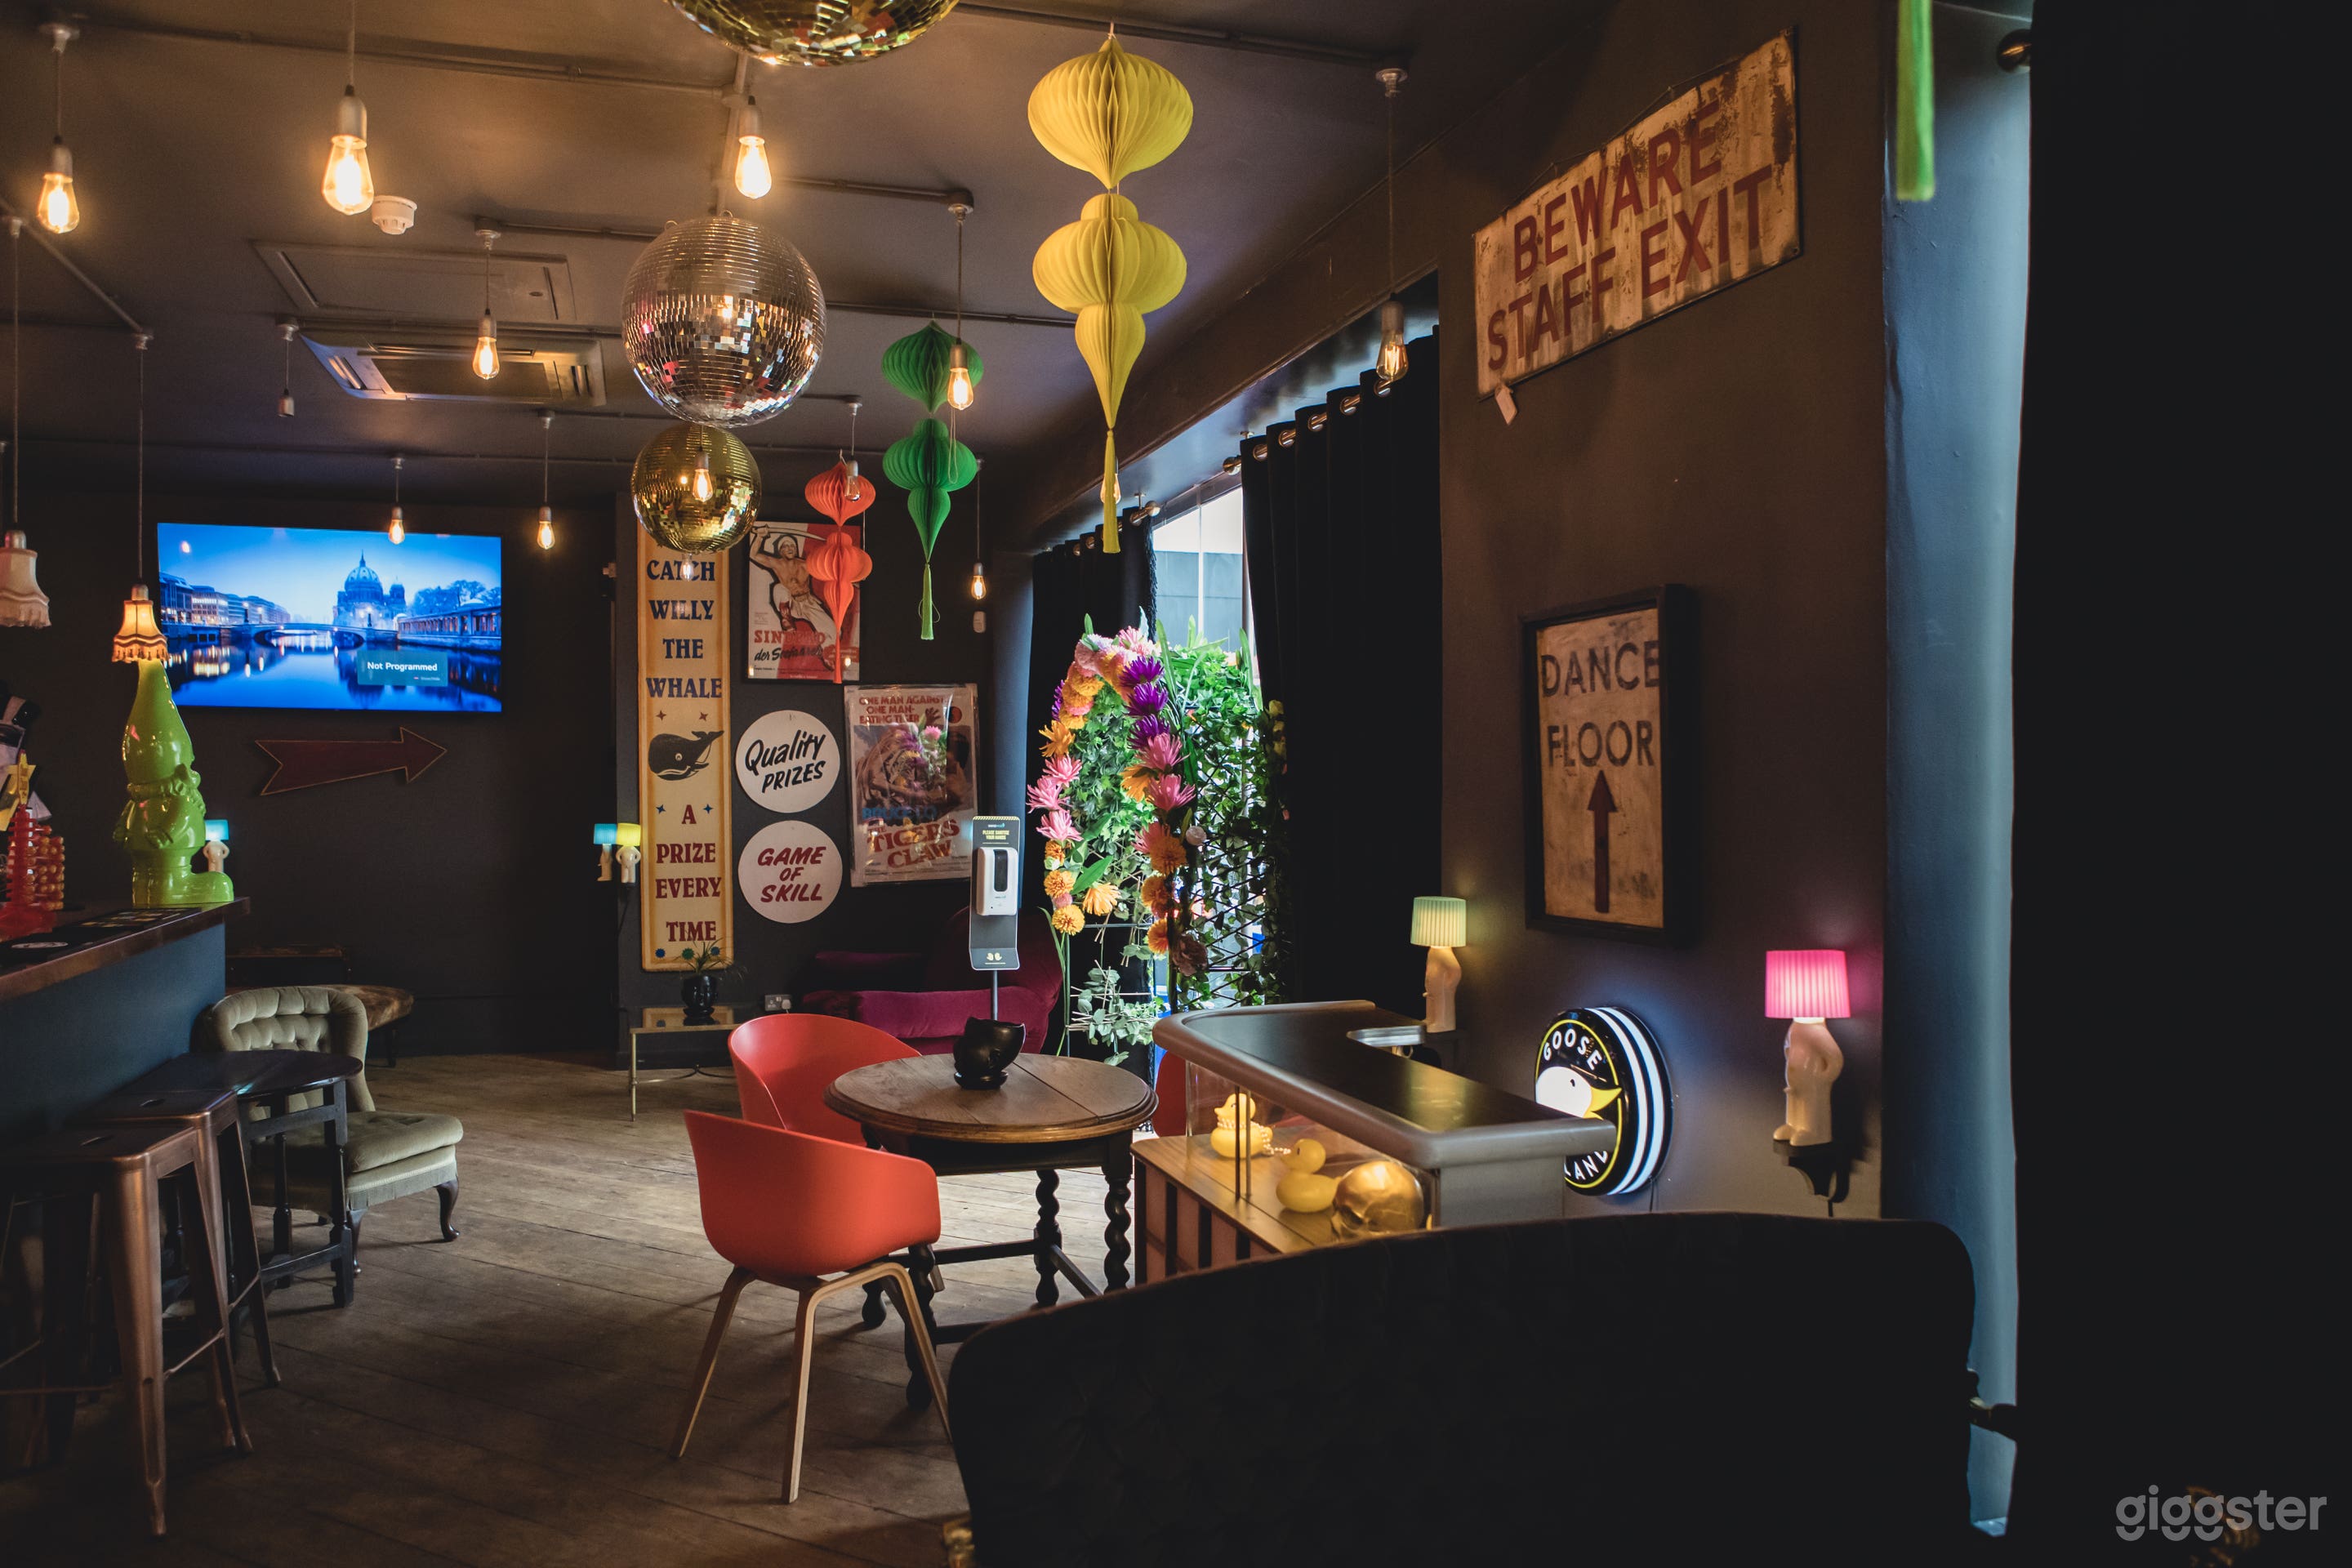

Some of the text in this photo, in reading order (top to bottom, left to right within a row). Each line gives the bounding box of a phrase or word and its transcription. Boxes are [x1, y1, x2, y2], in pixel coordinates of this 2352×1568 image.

[1514, 99, 1722, 284] BEWARE
[1487, 164, 1772, 370] STAFF EXIT
[648, 599, 715, 621] WILLY
[662, 638, 703, 659] THE
[754, 648, 770, 661] der
[367, 662, 438, 672] Not Programmed
[1541, 639, 1660, 697] DANCE
[645, 677, 722, 699] WHALE
[859, 696, 879, 706] ONE
[880, 696, 904, 706] MAN
[866, 705, 915, 715] ONE MAN-
[859, 714, 893, 724] EATING
[745, 729, 826, 776] Quality
[1547, 719, 1655, 767] FLOOR
[761, 760, 826, 794] PRIZES
[682, 804, 697, 824] A
[656, 843, 715, 864] PRIZE
[757, 846, 826, 866] GAME
[779, 866, 804, 882] OF
[656, 877, 722, 899] EVERY
[760, 884, 822, 903] SKILL
[666, 921, 716, 942] TIME
[1544, 1029, 1602, 1070] GOOSE
